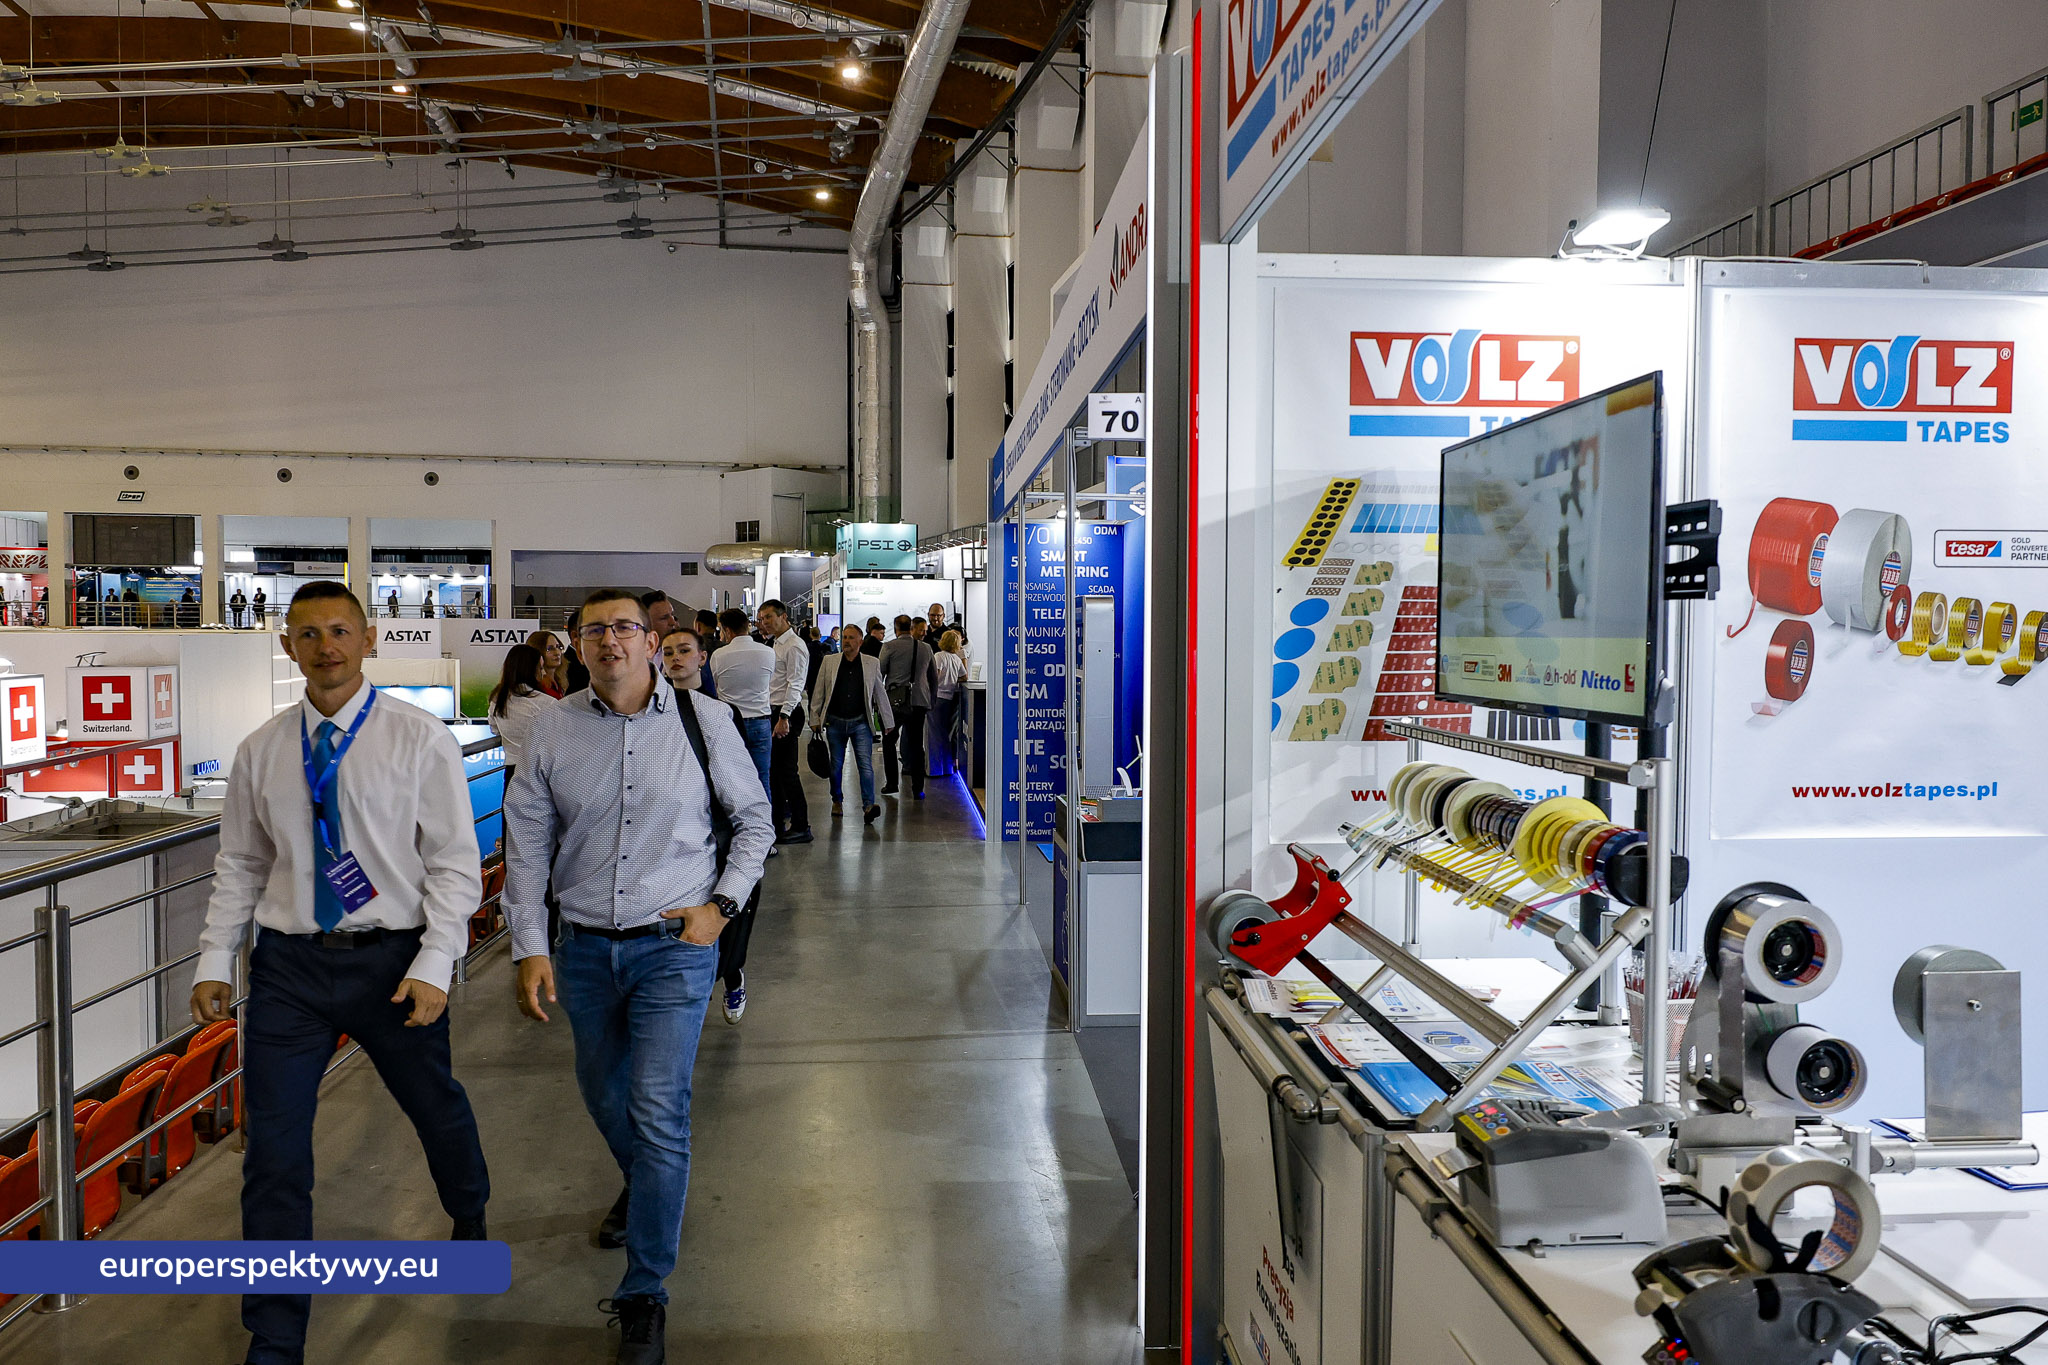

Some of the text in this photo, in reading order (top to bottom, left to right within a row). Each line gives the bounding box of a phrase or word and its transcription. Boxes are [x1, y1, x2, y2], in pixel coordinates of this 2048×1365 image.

[1272, 0, 1391, 158] www.volztapes.p
[1135, 396, 1142, 404] A
[1101, 410, 1139, 433] 70
[1917, 421, 2009, 443] TAPES
[1093, 526, 1117, 536] ODM
[857, 539, 894, 551] PSI
[1949, 542, 1985, 556] tesa
[1008, 582, 1057, 593] TRNSMISJA
[1088, 585, 1115, 594] SCADA
[384, 630, 432, 642] ASTAT
[470, 629, 529, 643] ASTAT
[1497, 663, 1513, 683] 3M
[1580, 669, 1622, 691] Nitto
[82, 724, 133, 733] Switzerland.
[1792, 781, 1998, 801] www.volztapes.pl
